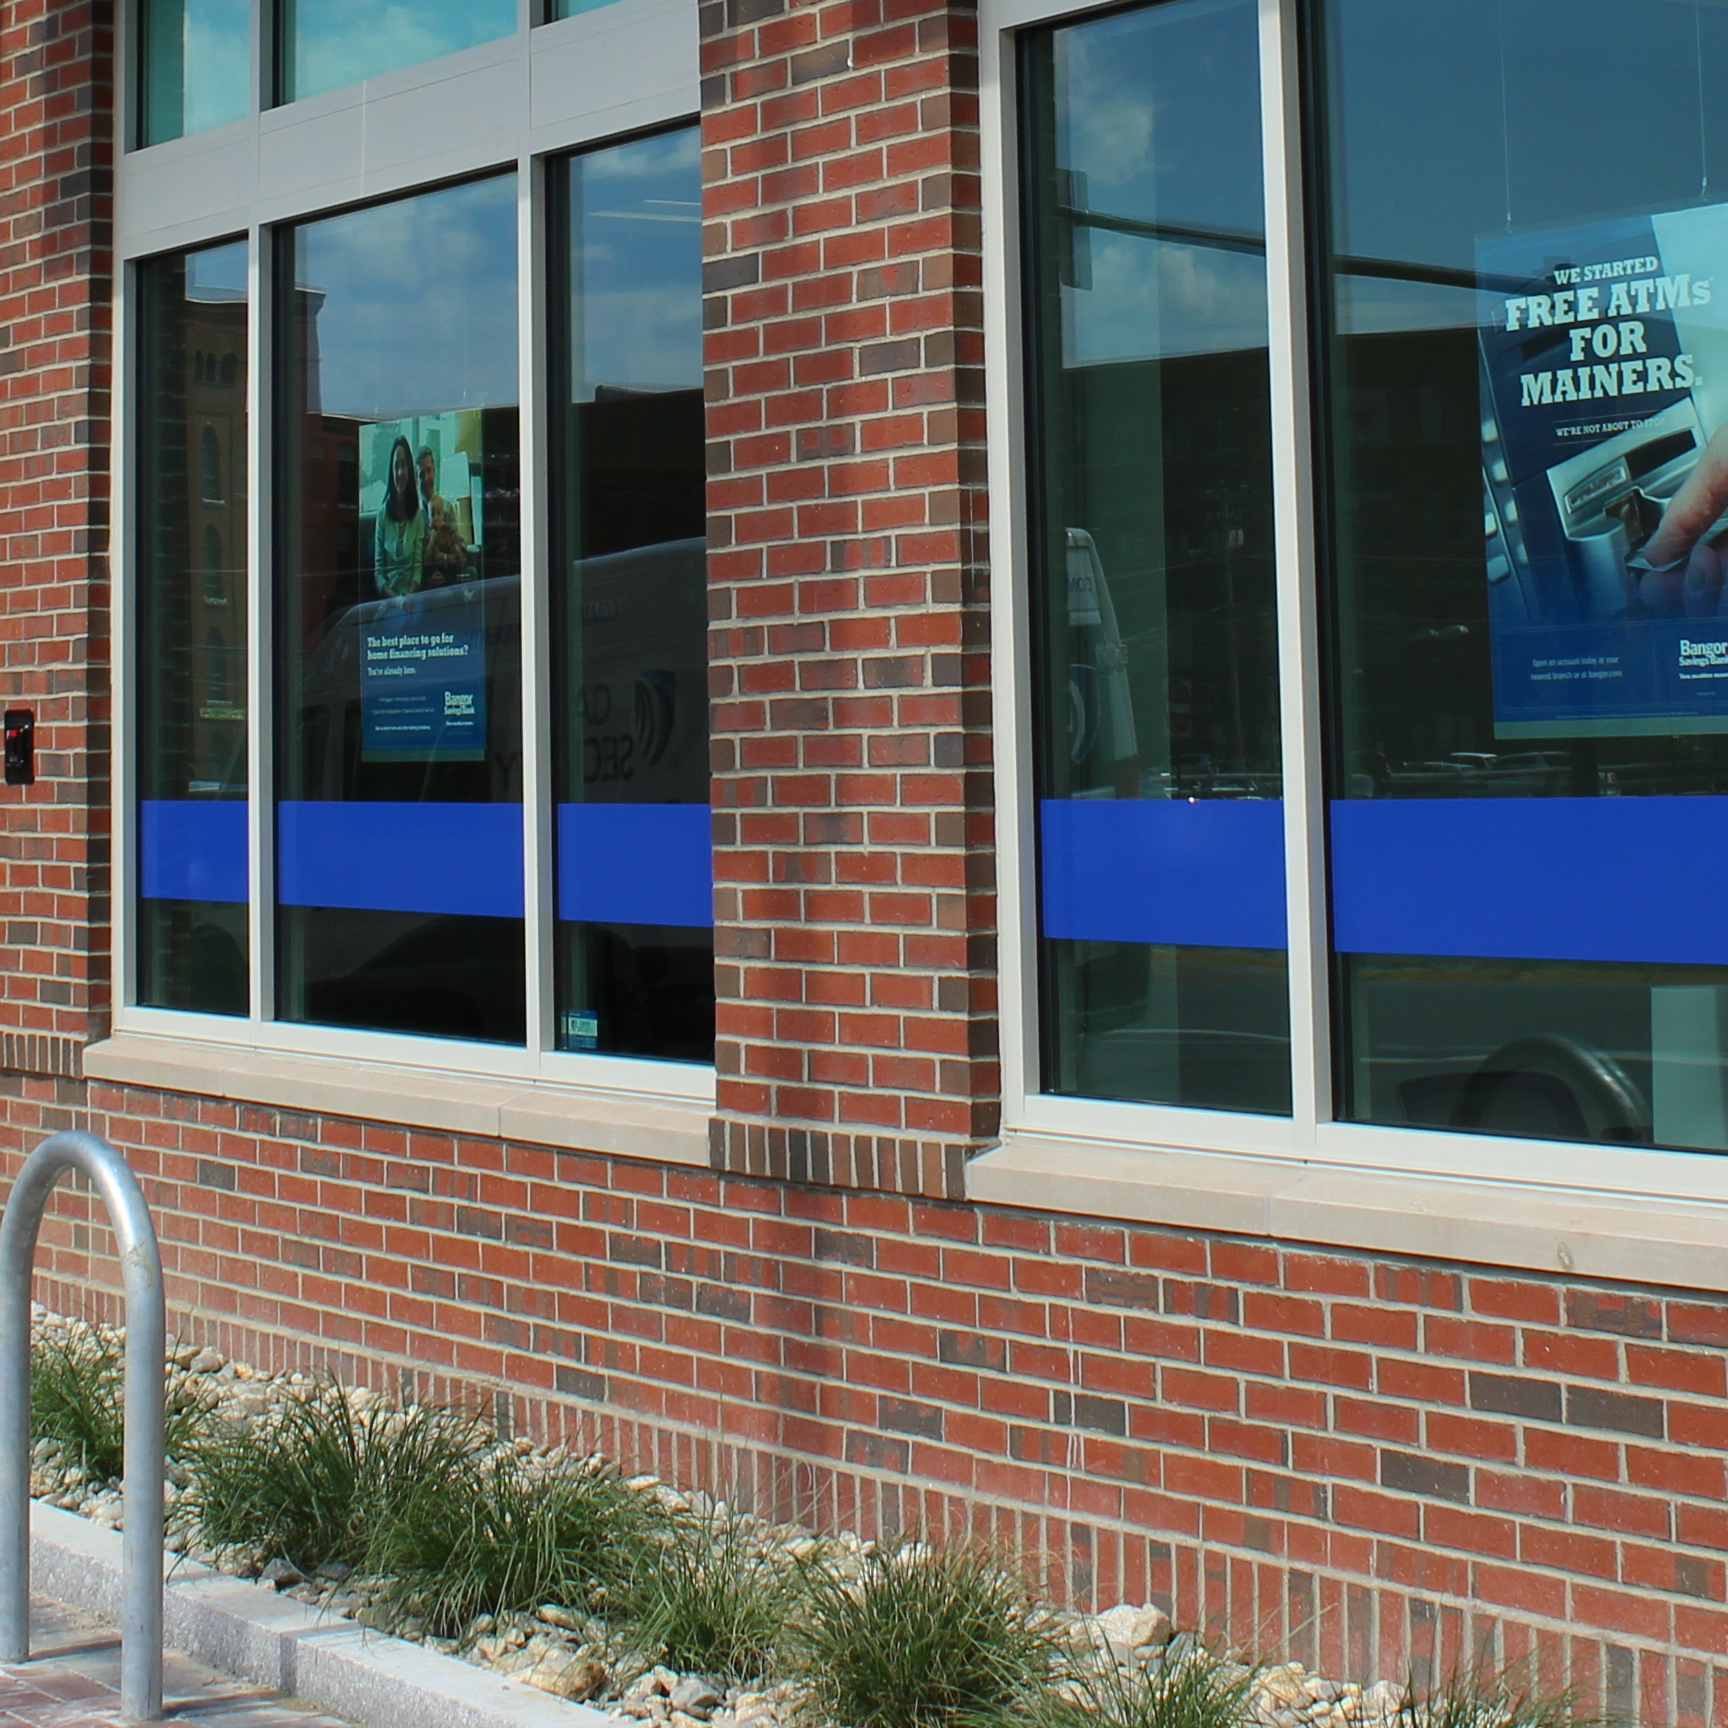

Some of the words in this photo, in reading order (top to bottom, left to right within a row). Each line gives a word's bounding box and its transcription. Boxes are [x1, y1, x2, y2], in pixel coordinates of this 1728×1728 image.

[1553, 267, 1580, 285] WE
[1584, 256, 1658, 281] STARTED
[1505, 286, 1600, 332] FREE
[1569, 320, 1647, 361] FOR
[1520, 353, 1703, 407] MAINERS.
[1583, 424, 1601, 434] NOT
[1602, 420, 1629, 432] ABOUT
[1631, 419, 1643, 429] TO
[367, 637, 381, 647] The
[381, 636, 398, 647] best
[399, 635, 419, 648] place
[420, 635, 429, 644] to
[430, 636, 440, 646] go
[441, 632, 454, 643] for
[367, 650, 388, 660] home
[389, 647, 426, 660] financing
[428, 644, 469, 658] solutions?
[1679, 639, 1728, 659] Bangor
